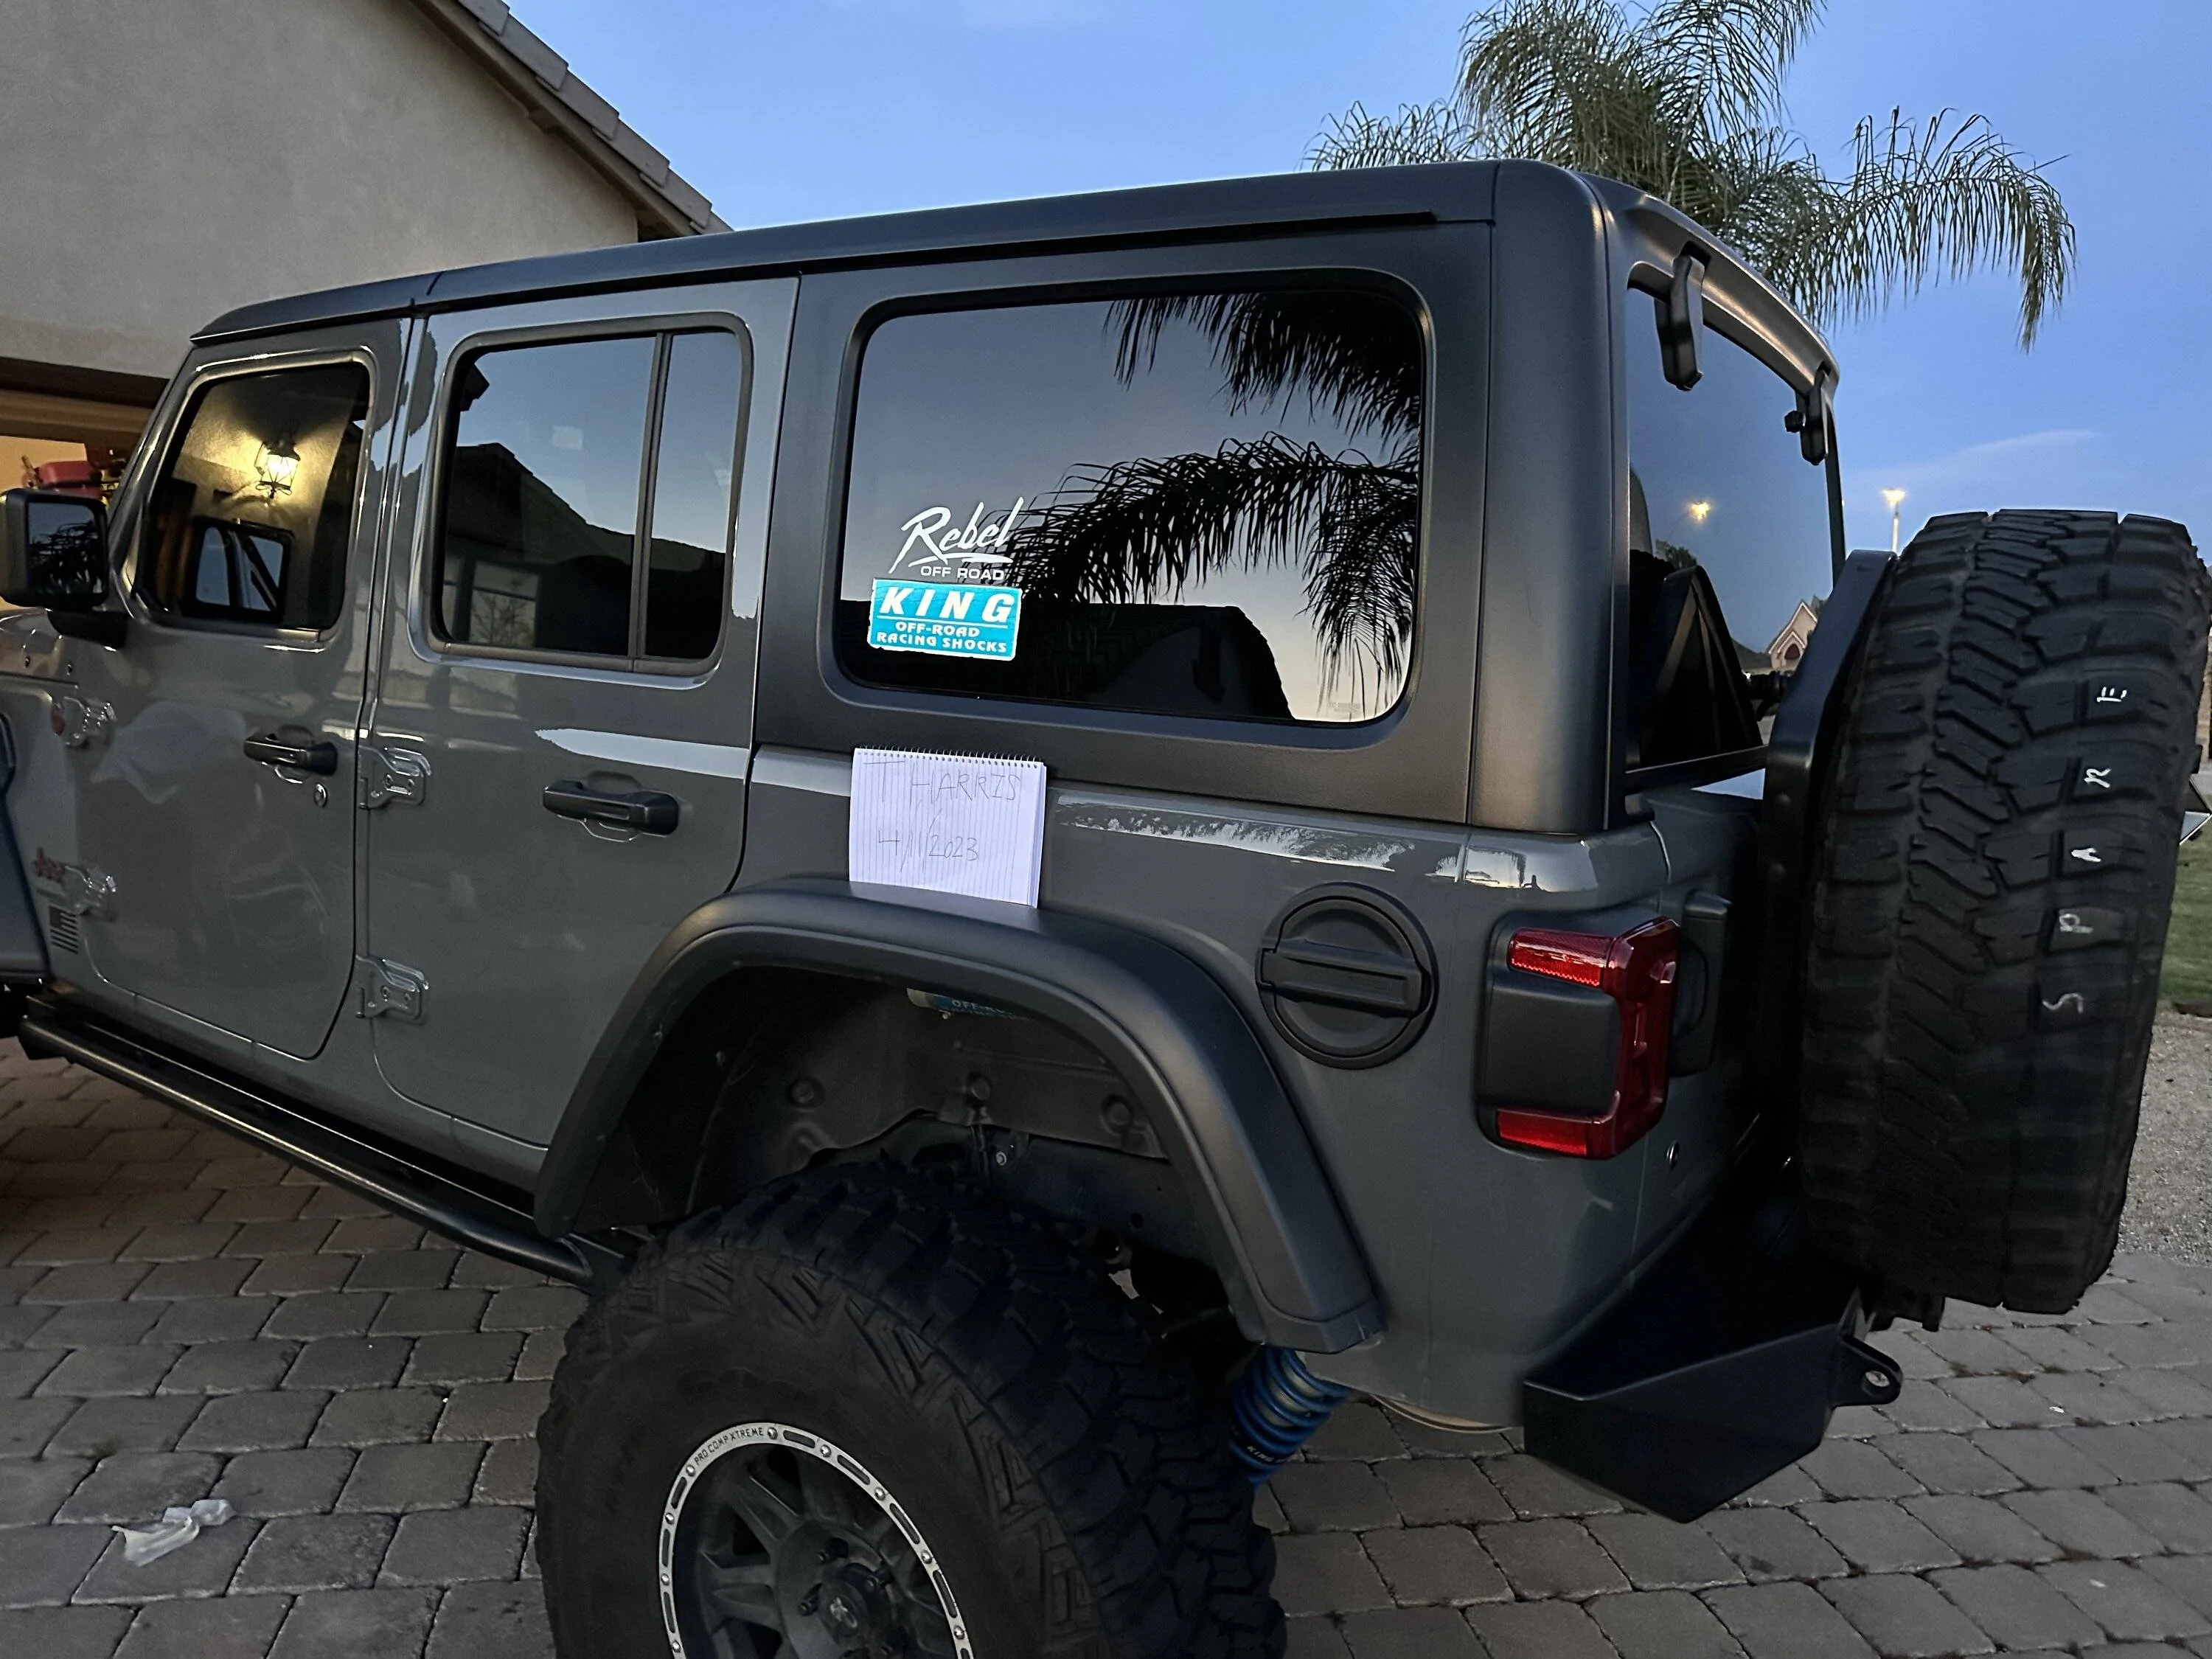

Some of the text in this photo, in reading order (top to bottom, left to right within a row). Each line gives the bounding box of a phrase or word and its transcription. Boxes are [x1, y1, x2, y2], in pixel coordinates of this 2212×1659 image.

[888, 496, 1023, 574] Rebel
[920, 566, 1004, 580] OFF ROAD
[881, 588, 1015, 622] KING
[877, 632, 1006, 653] RACING SHOCKS
[895, 621, 980, 637] OFF-ROAD
[694, 1427, 763, 1464] PRO COMP XTREME
